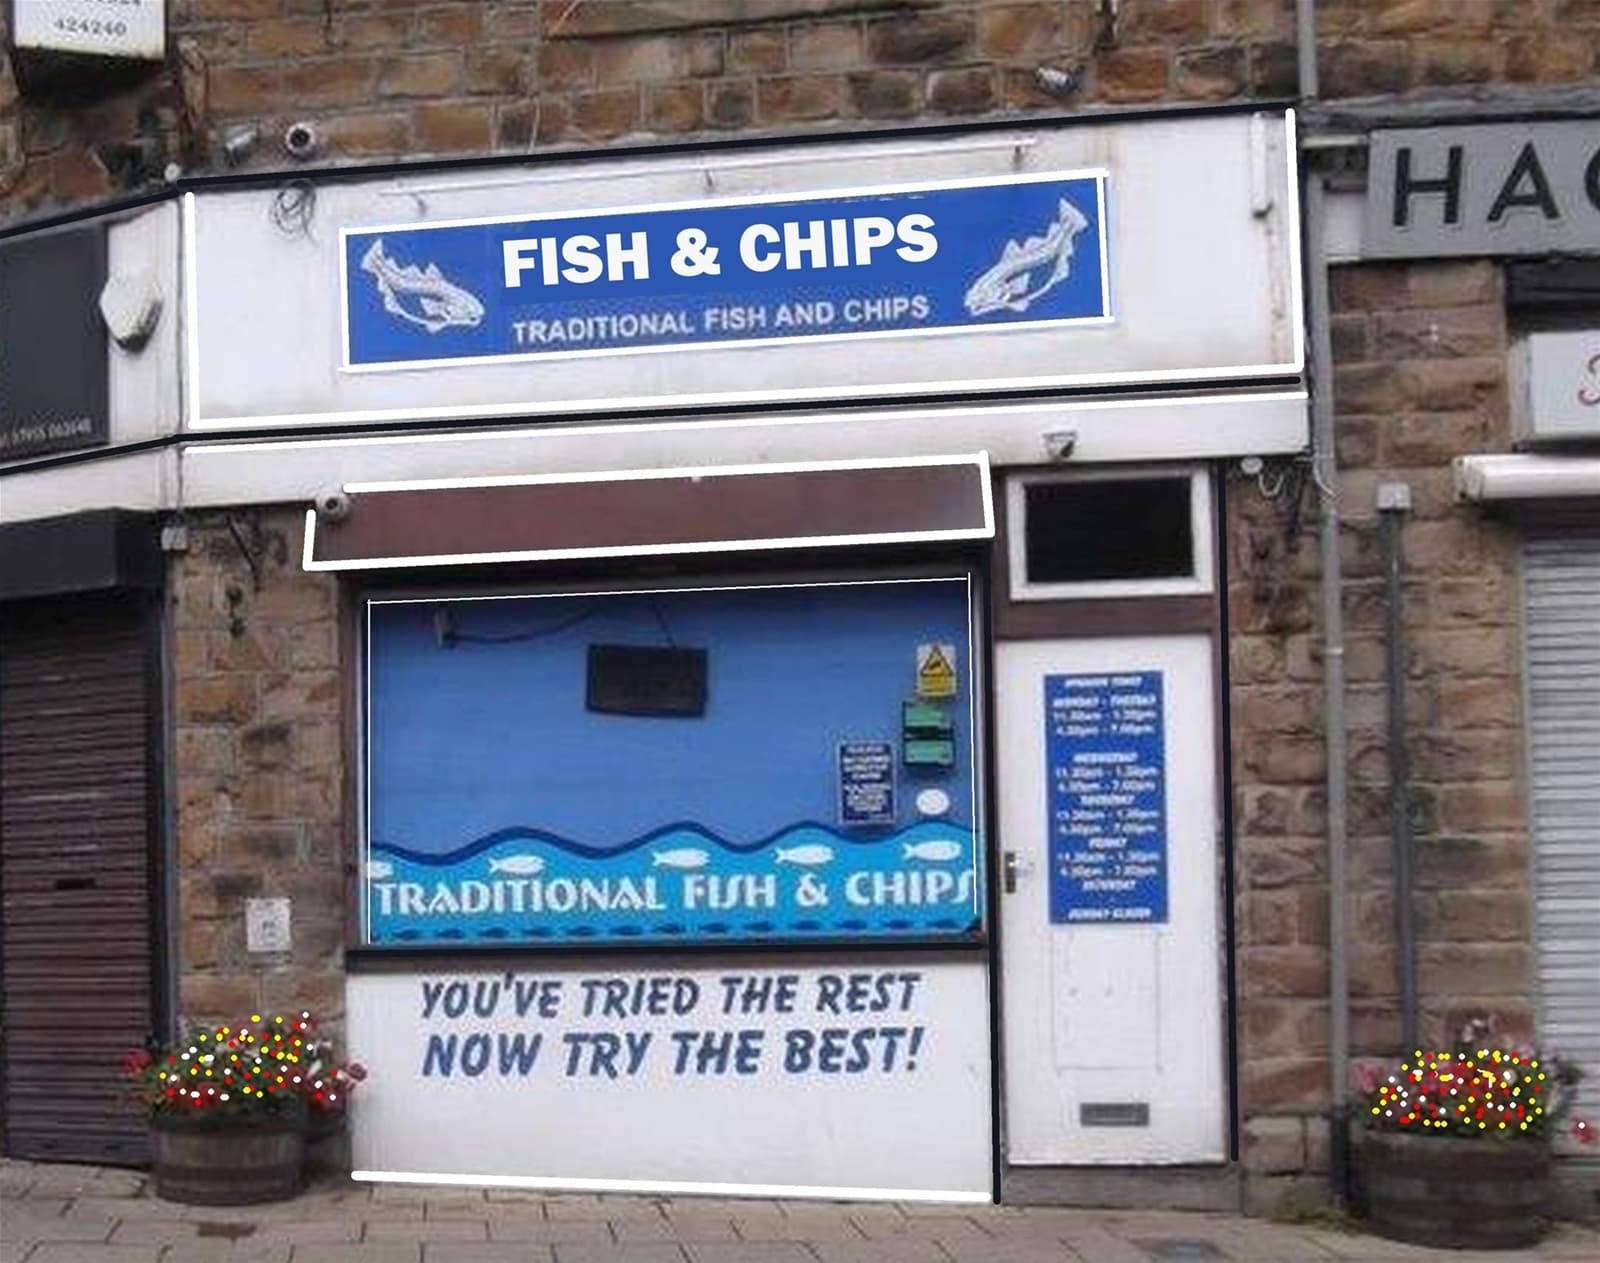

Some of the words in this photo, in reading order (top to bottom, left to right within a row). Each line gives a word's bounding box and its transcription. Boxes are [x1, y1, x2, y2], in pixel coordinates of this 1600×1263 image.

[1393, 142, 1600, 226] HA
[503, 231, 649, 288] FISH
[670, 228, 721, 277] &
[739, 213, 938, 273] CHIPS
[514, 315, 694, 343] TRADITIONAL
[705, 307, 766, 332] FISH
[774, 301, 834, 326] AND
[844, 295, 929, 323] CHIPS
[374, 875, 667, 915] TRADITIONAL
[684, 873, 775, 909] FISH
[796, 873, 828, 906] &
[845, 869, 974, 906] CHIPS
[421, 970, 562, 1018] YOU'VE
[581, 977, 699, 1018] TRIED
[720, 975, 799, 1013] THE
[816, 972, 921, 1014] REST
[422, 1032, 542, 1077] NOW
[563, 1031, 650, 1079] TRY
[671, 1030, 765, 1075] THE
[784, 1026, 924, 1074] BEST!
